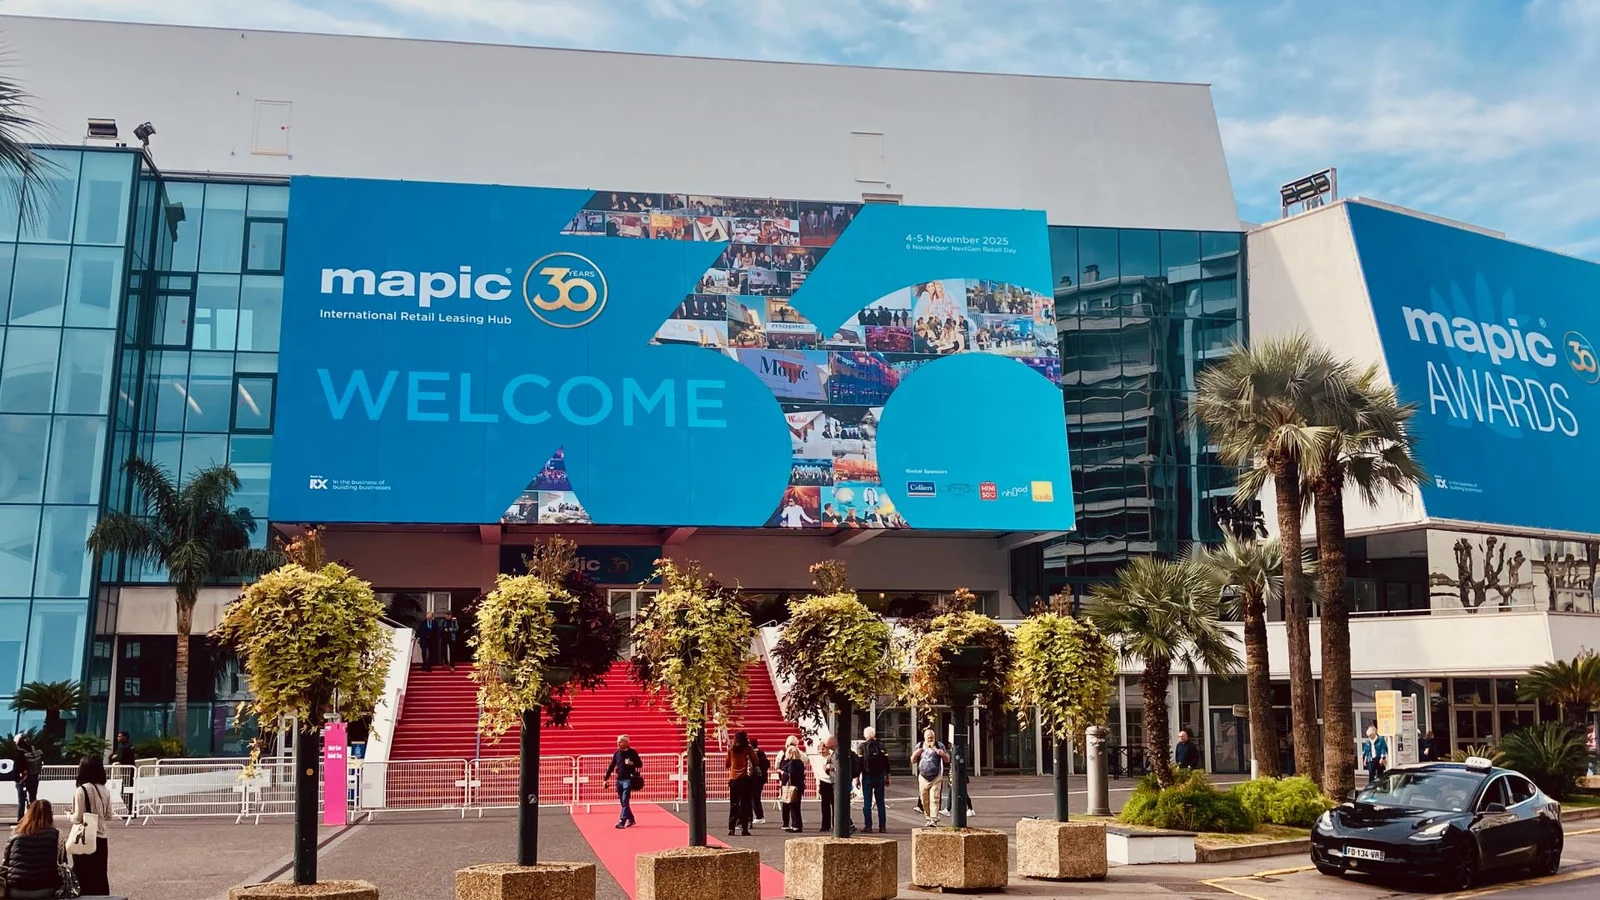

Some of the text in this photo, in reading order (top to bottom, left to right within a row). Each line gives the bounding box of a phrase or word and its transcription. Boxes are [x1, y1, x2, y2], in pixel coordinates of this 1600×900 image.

[906, 234, 1009, 246] 4-5 November 2025
[320, 265, 512, 308] mapic
[533, 266, 598, 312] 30
[568, 269, 595, 278] YEARS
[320, 308, 512, 325] International Retail Leasing Hub
[1402, 306, 1557, 368] mapic
[760, 356, 809, 384] Mapic
[1568, 341, 1596, 373] 30
[317, 368, 727, 428] WELCOME
[1426, 360, 1579, 437] AWARDS
[310, 479, 328, 490] RX
